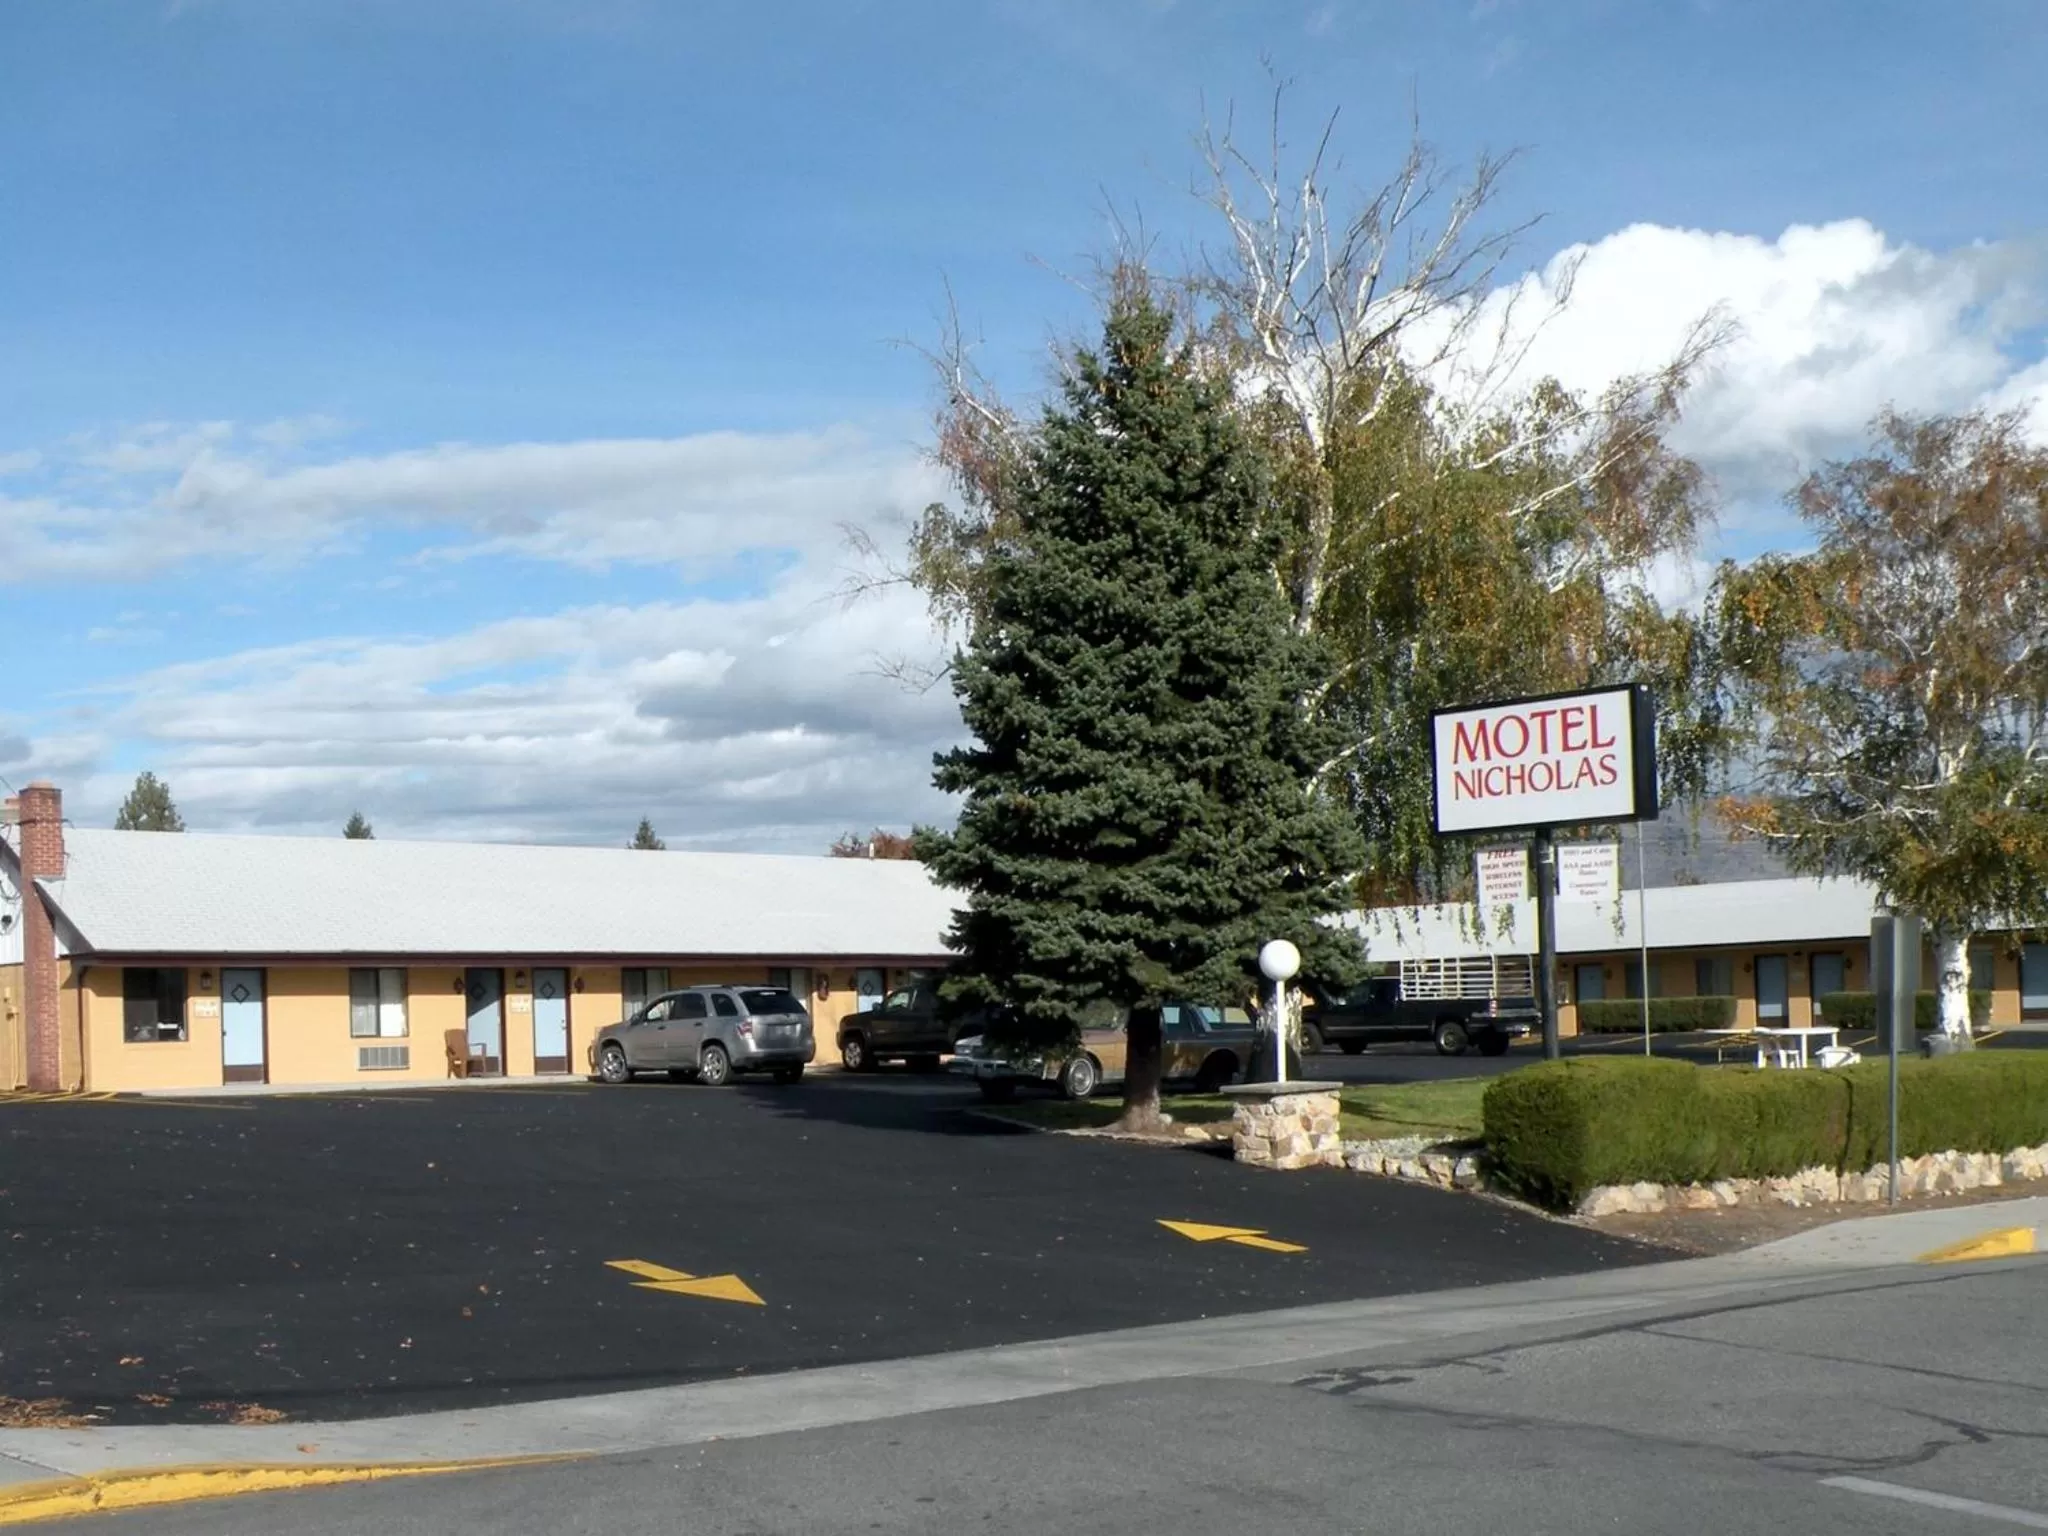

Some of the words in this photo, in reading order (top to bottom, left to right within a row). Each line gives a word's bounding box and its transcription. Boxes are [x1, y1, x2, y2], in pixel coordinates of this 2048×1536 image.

[1453, 705, 1616, 764] MOTEL
[1454, 754, 1617, 800] NICHOLAS
[1487, 848, 1516, 860] FREE
[1486, 871, 1522, 880] WIRELESS
[1486, 881, 1522, 891] INTERNET
[1492, 892, 1519, 900] ACCESS
